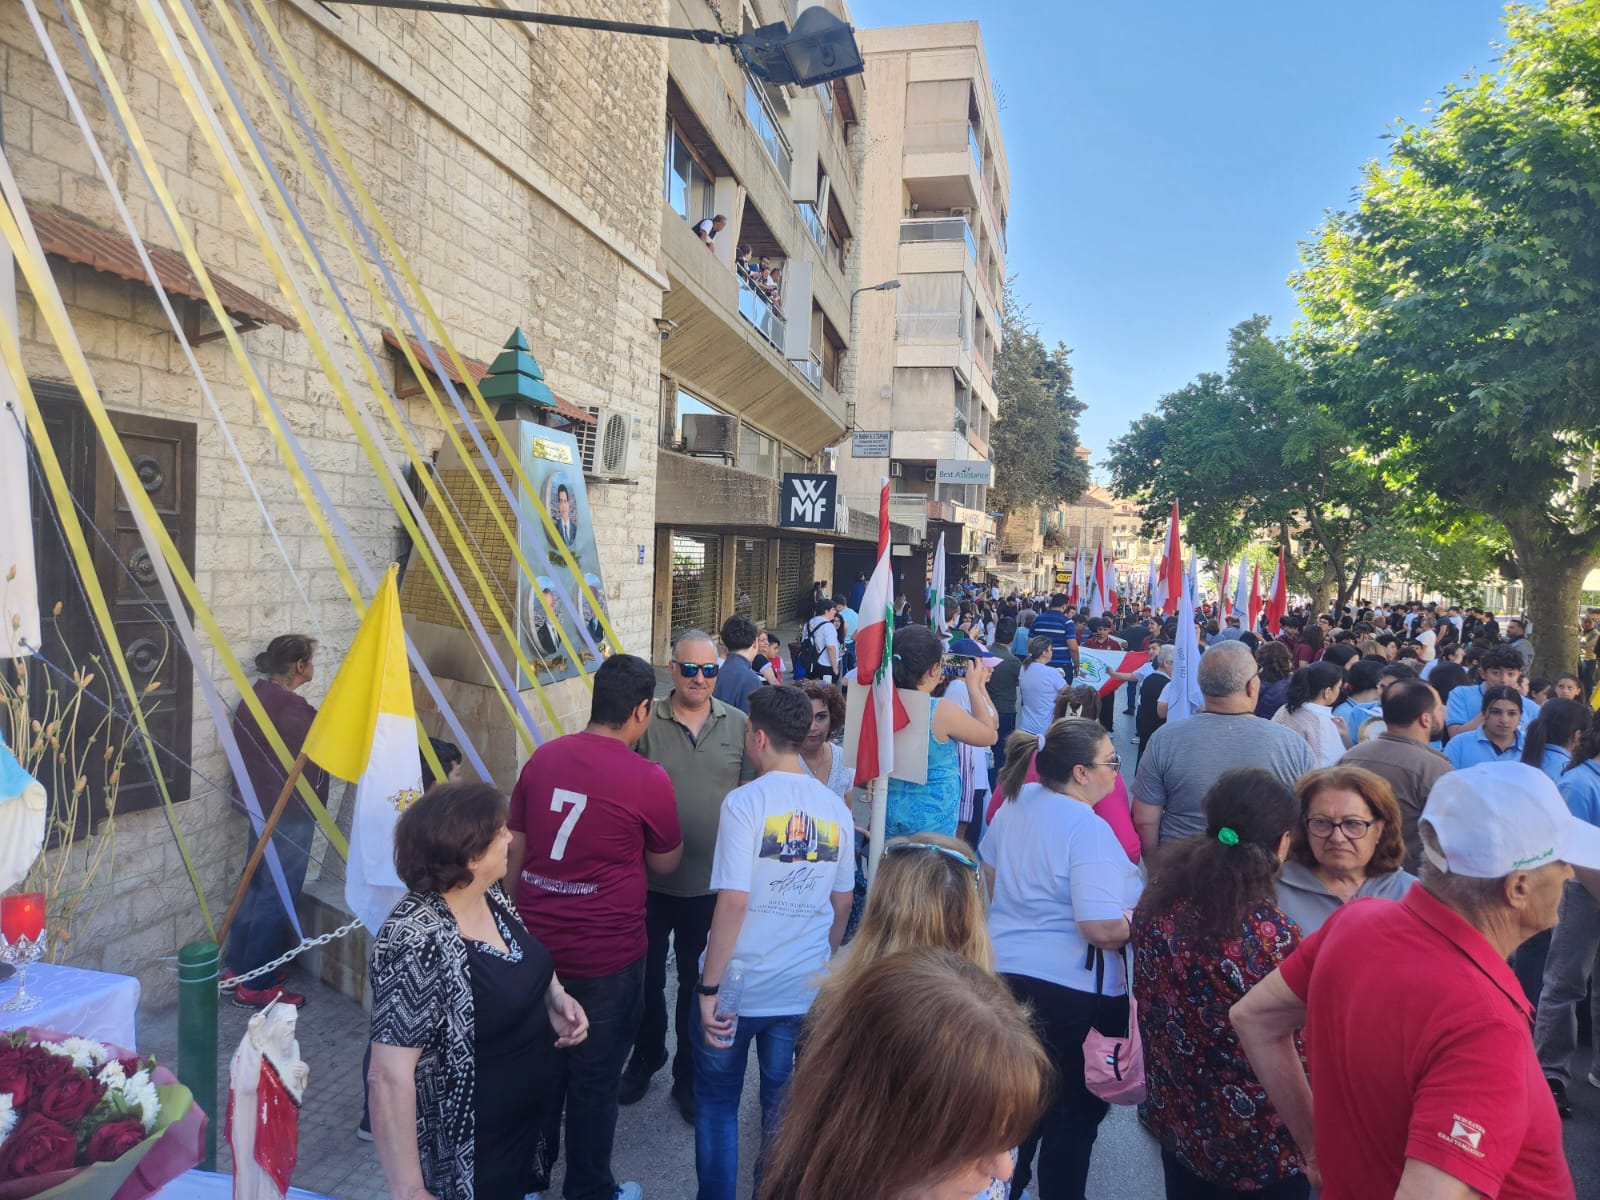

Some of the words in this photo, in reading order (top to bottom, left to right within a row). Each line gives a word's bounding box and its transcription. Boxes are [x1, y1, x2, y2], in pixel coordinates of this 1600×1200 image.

[939, 470, 954, 478] Best
[790, 479, 828, 523] WMF
[549, 787, 588, 861] 7
